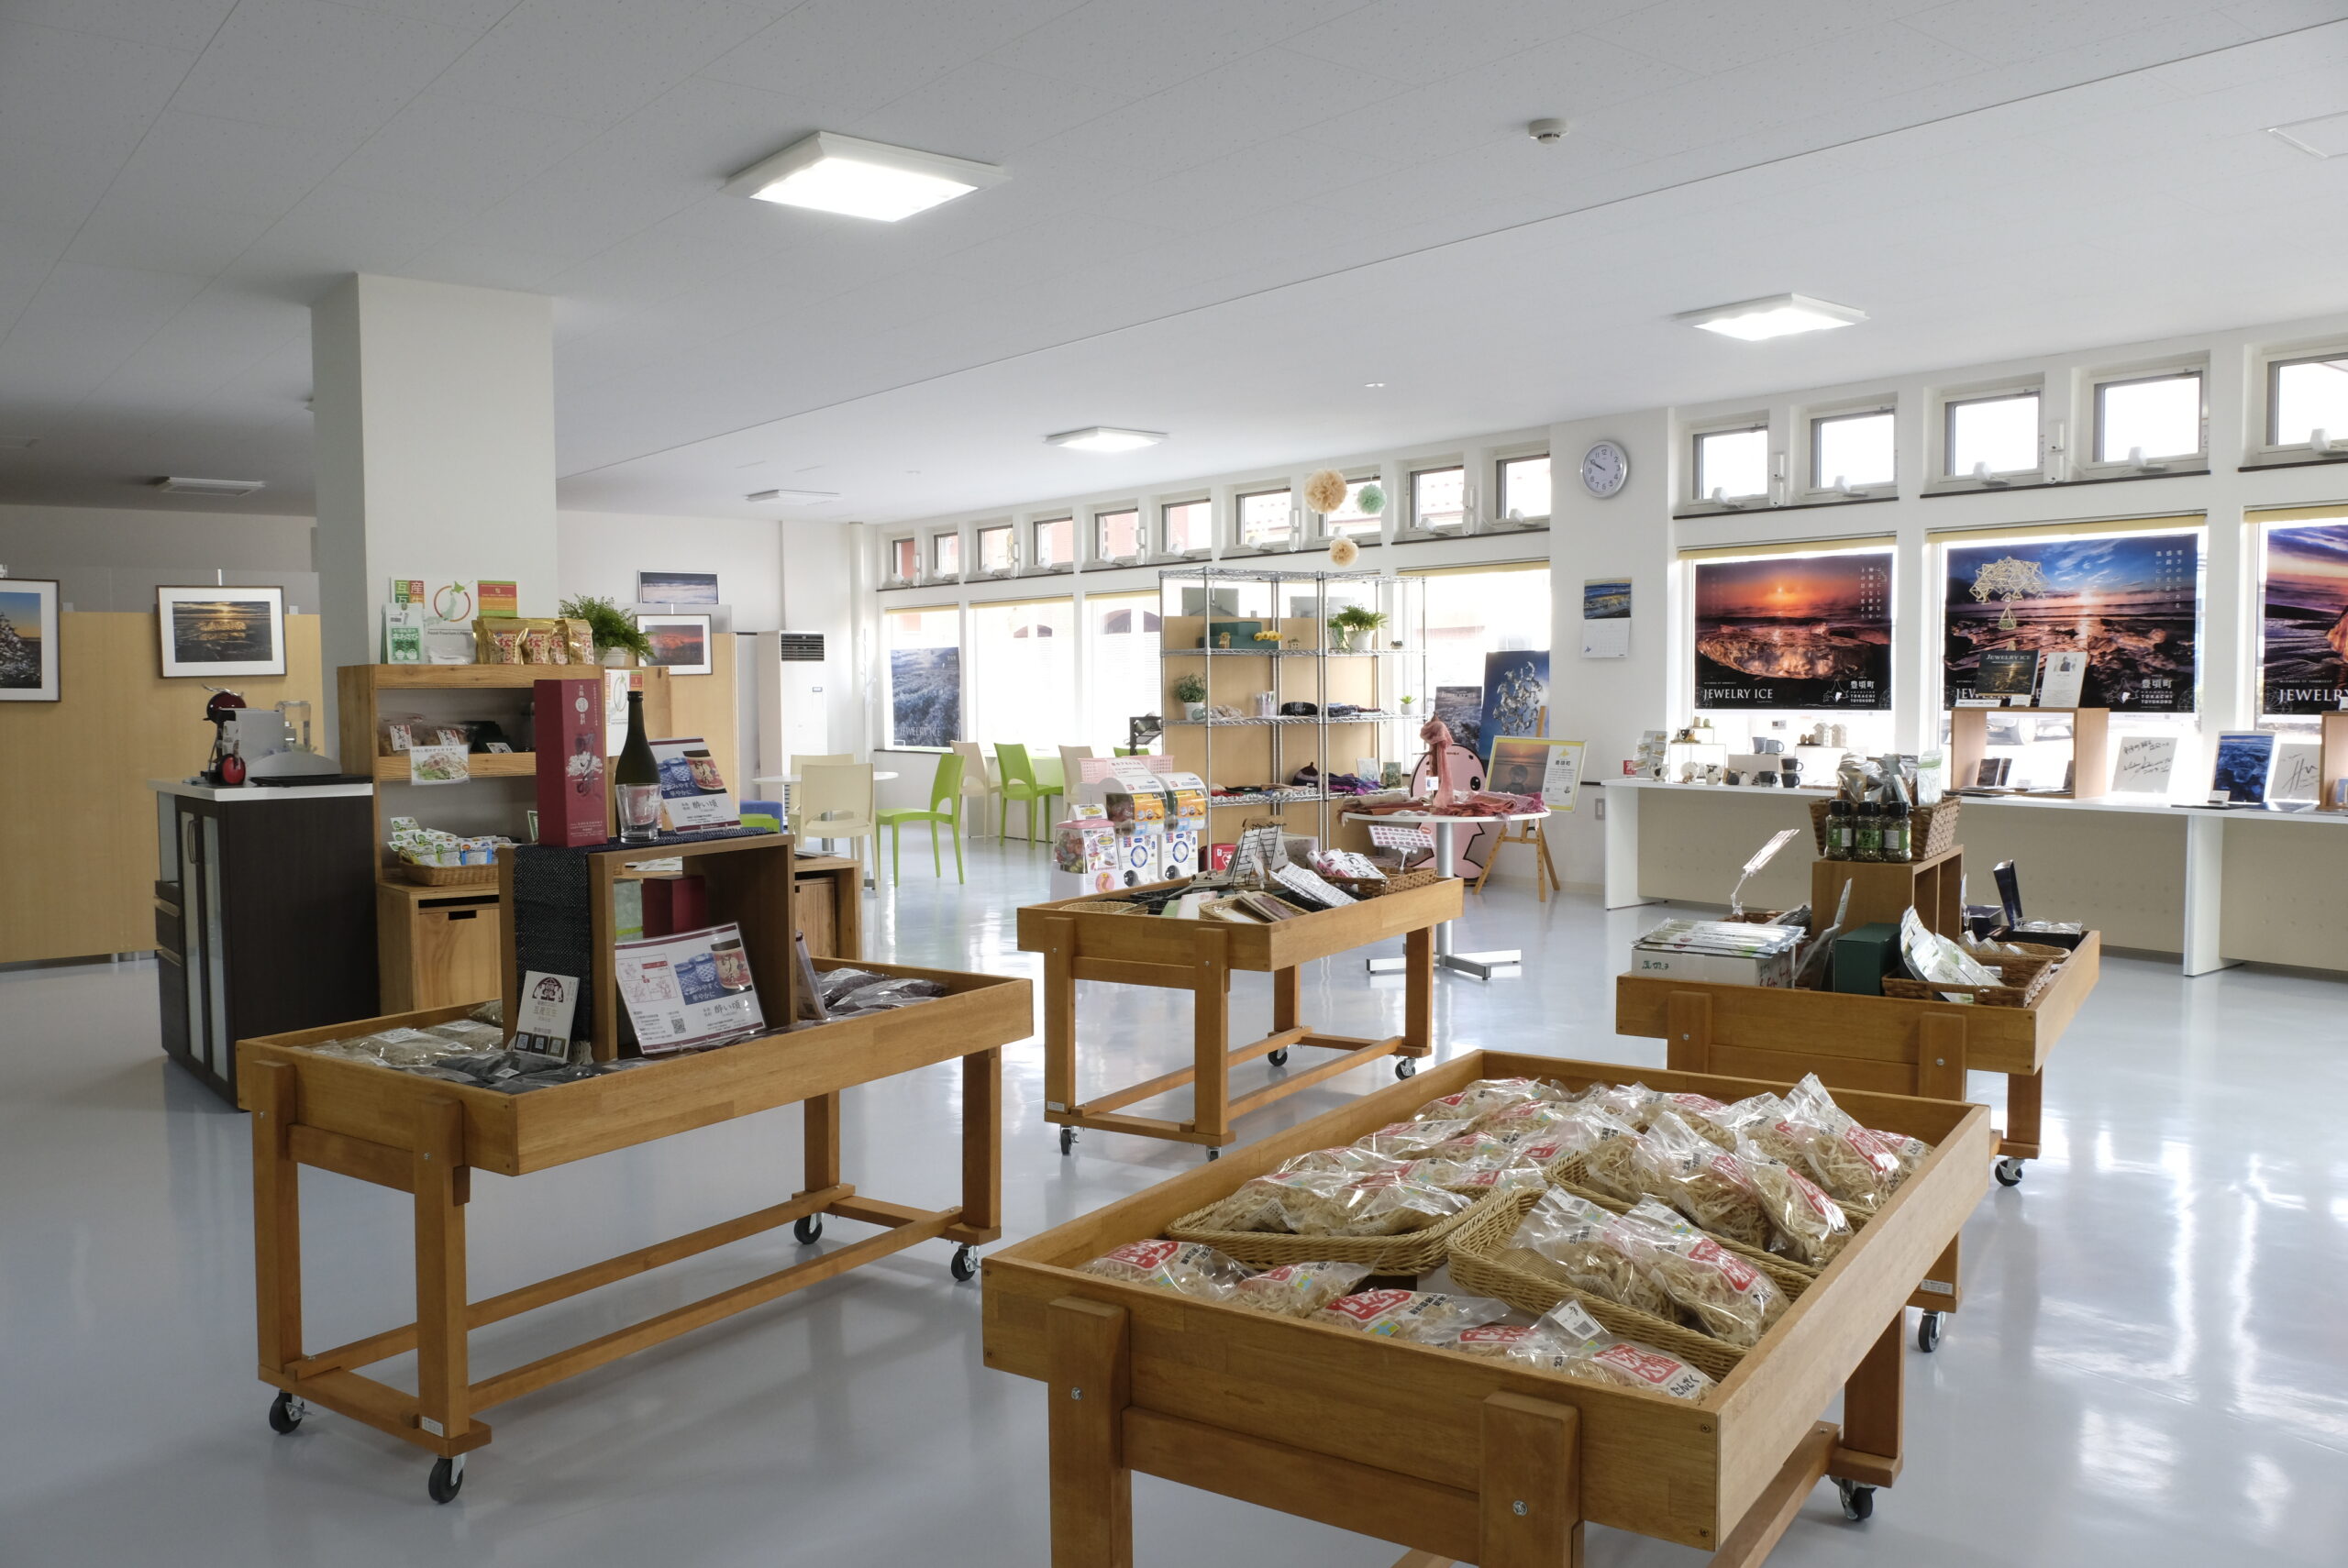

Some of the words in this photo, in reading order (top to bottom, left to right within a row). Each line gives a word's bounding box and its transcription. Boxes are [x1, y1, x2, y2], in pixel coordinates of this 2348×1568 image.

[1850, 679, 1875, 690] 豊頃町
[2142, 679, 2172, 689] 豊頃町
[1704, 689, 1750, 700] JEWELRY
[1755, 689, 1773, 699] ICE
[714, 999, 741, 1013] 酔い頃
[1669, 1373, 1700, 1397] たんざく
